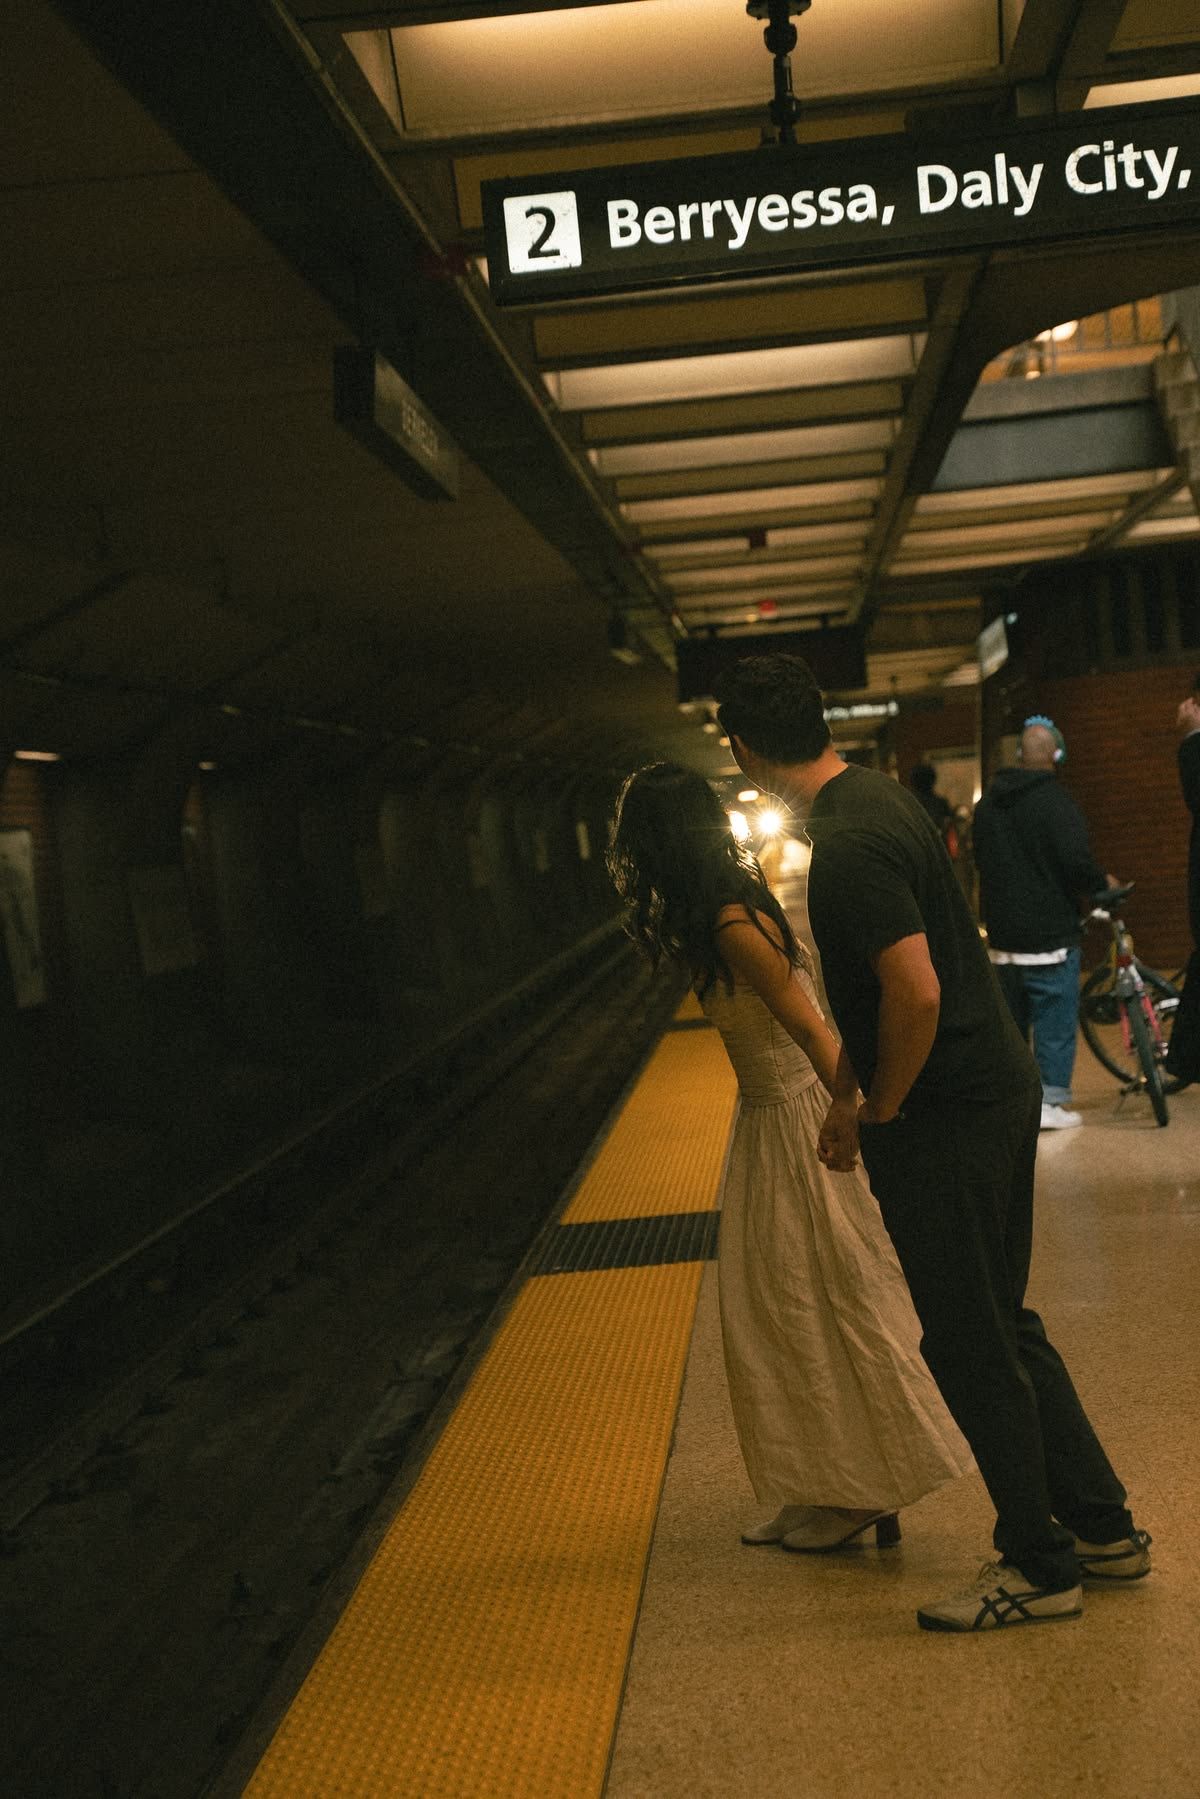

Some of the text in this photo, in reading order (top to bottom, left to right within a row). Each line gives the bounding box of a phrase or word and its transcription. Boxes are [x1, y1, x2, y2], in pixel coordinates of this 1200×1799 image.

[525, 140, 1192, 260] 2 Berryessa, Daly City,
